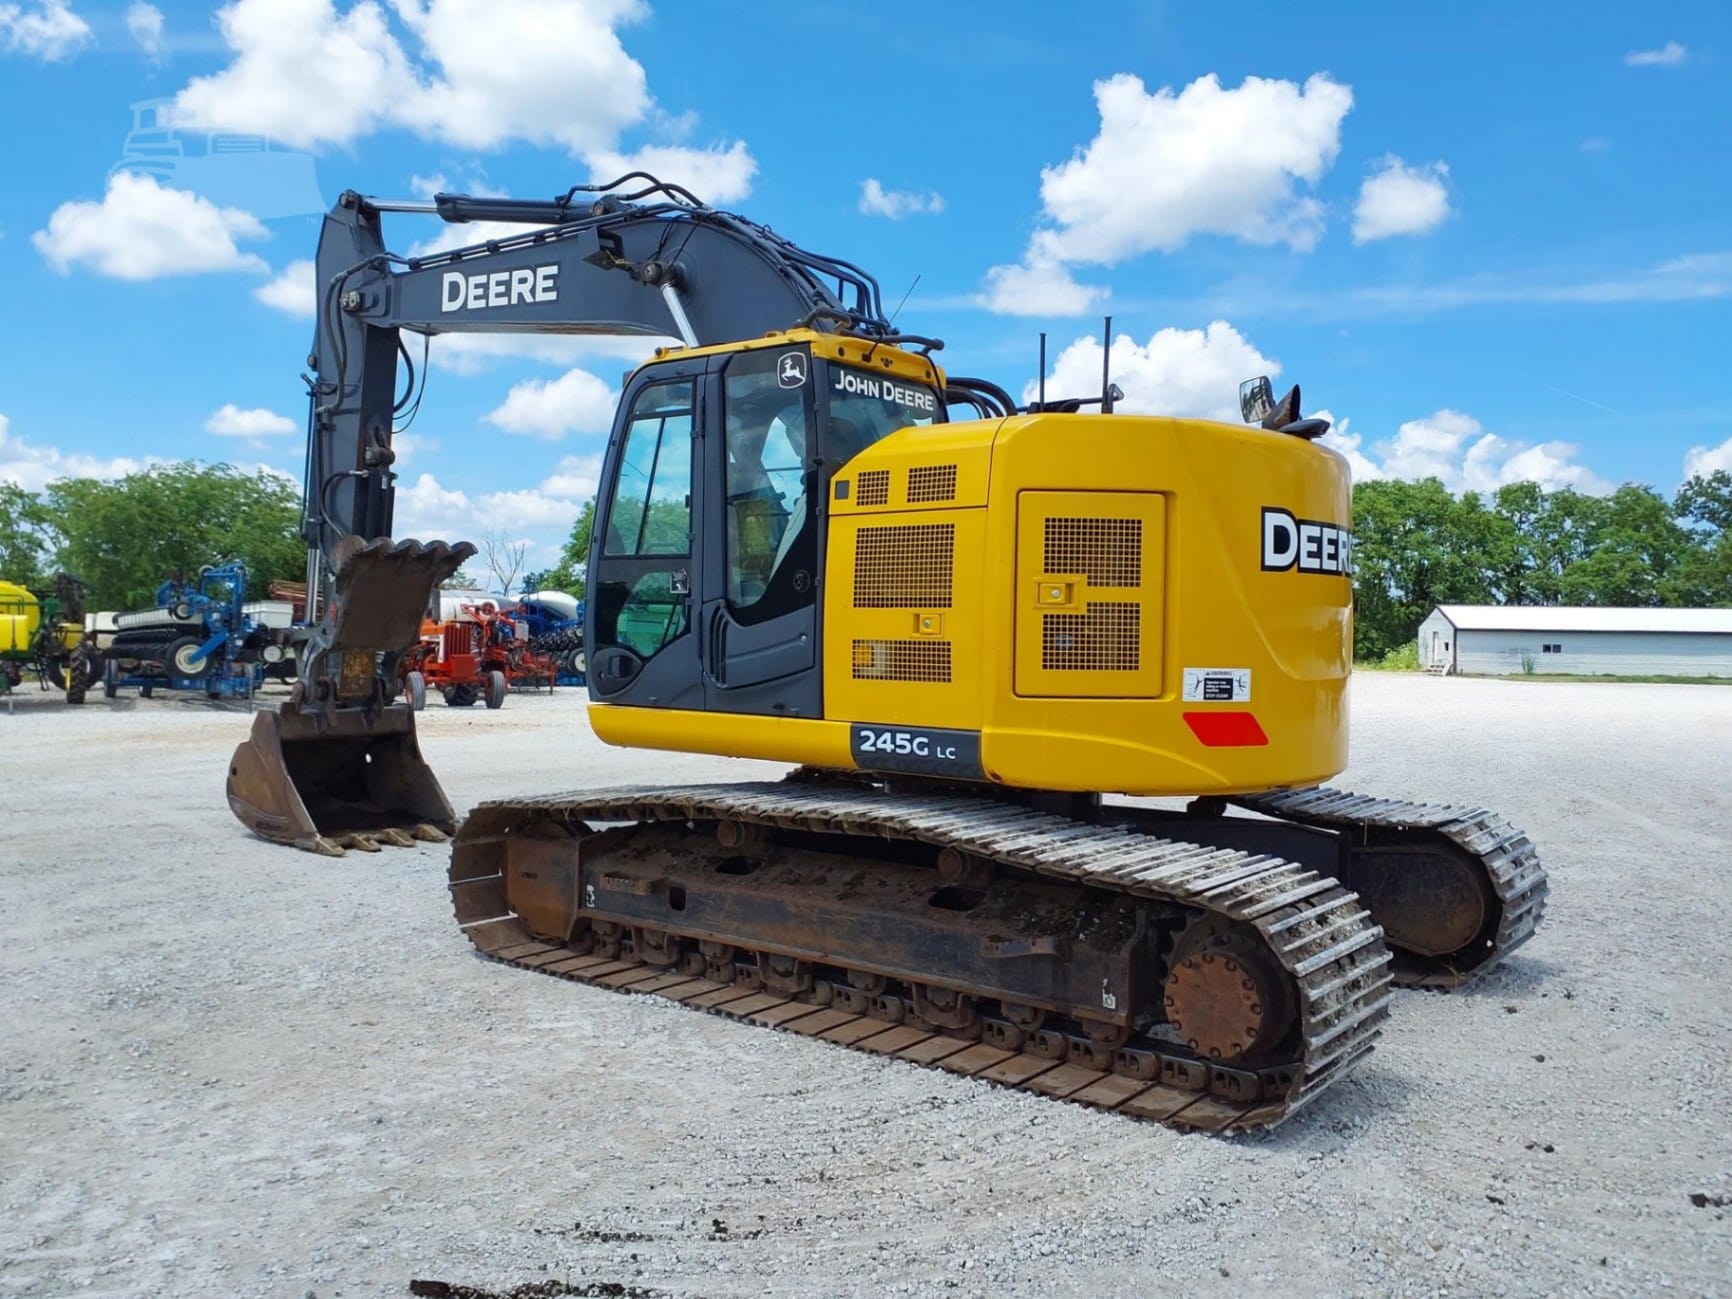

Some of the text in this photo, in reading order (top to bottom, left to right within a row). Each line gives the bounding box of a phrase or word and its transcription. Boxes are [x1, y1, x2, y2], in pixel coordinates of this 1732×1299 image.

[442, 265, 558, 312] DEERE
[835, 370, 934, 411] JOHN DEERE
[860, 730, 956, 759] 245G LC
